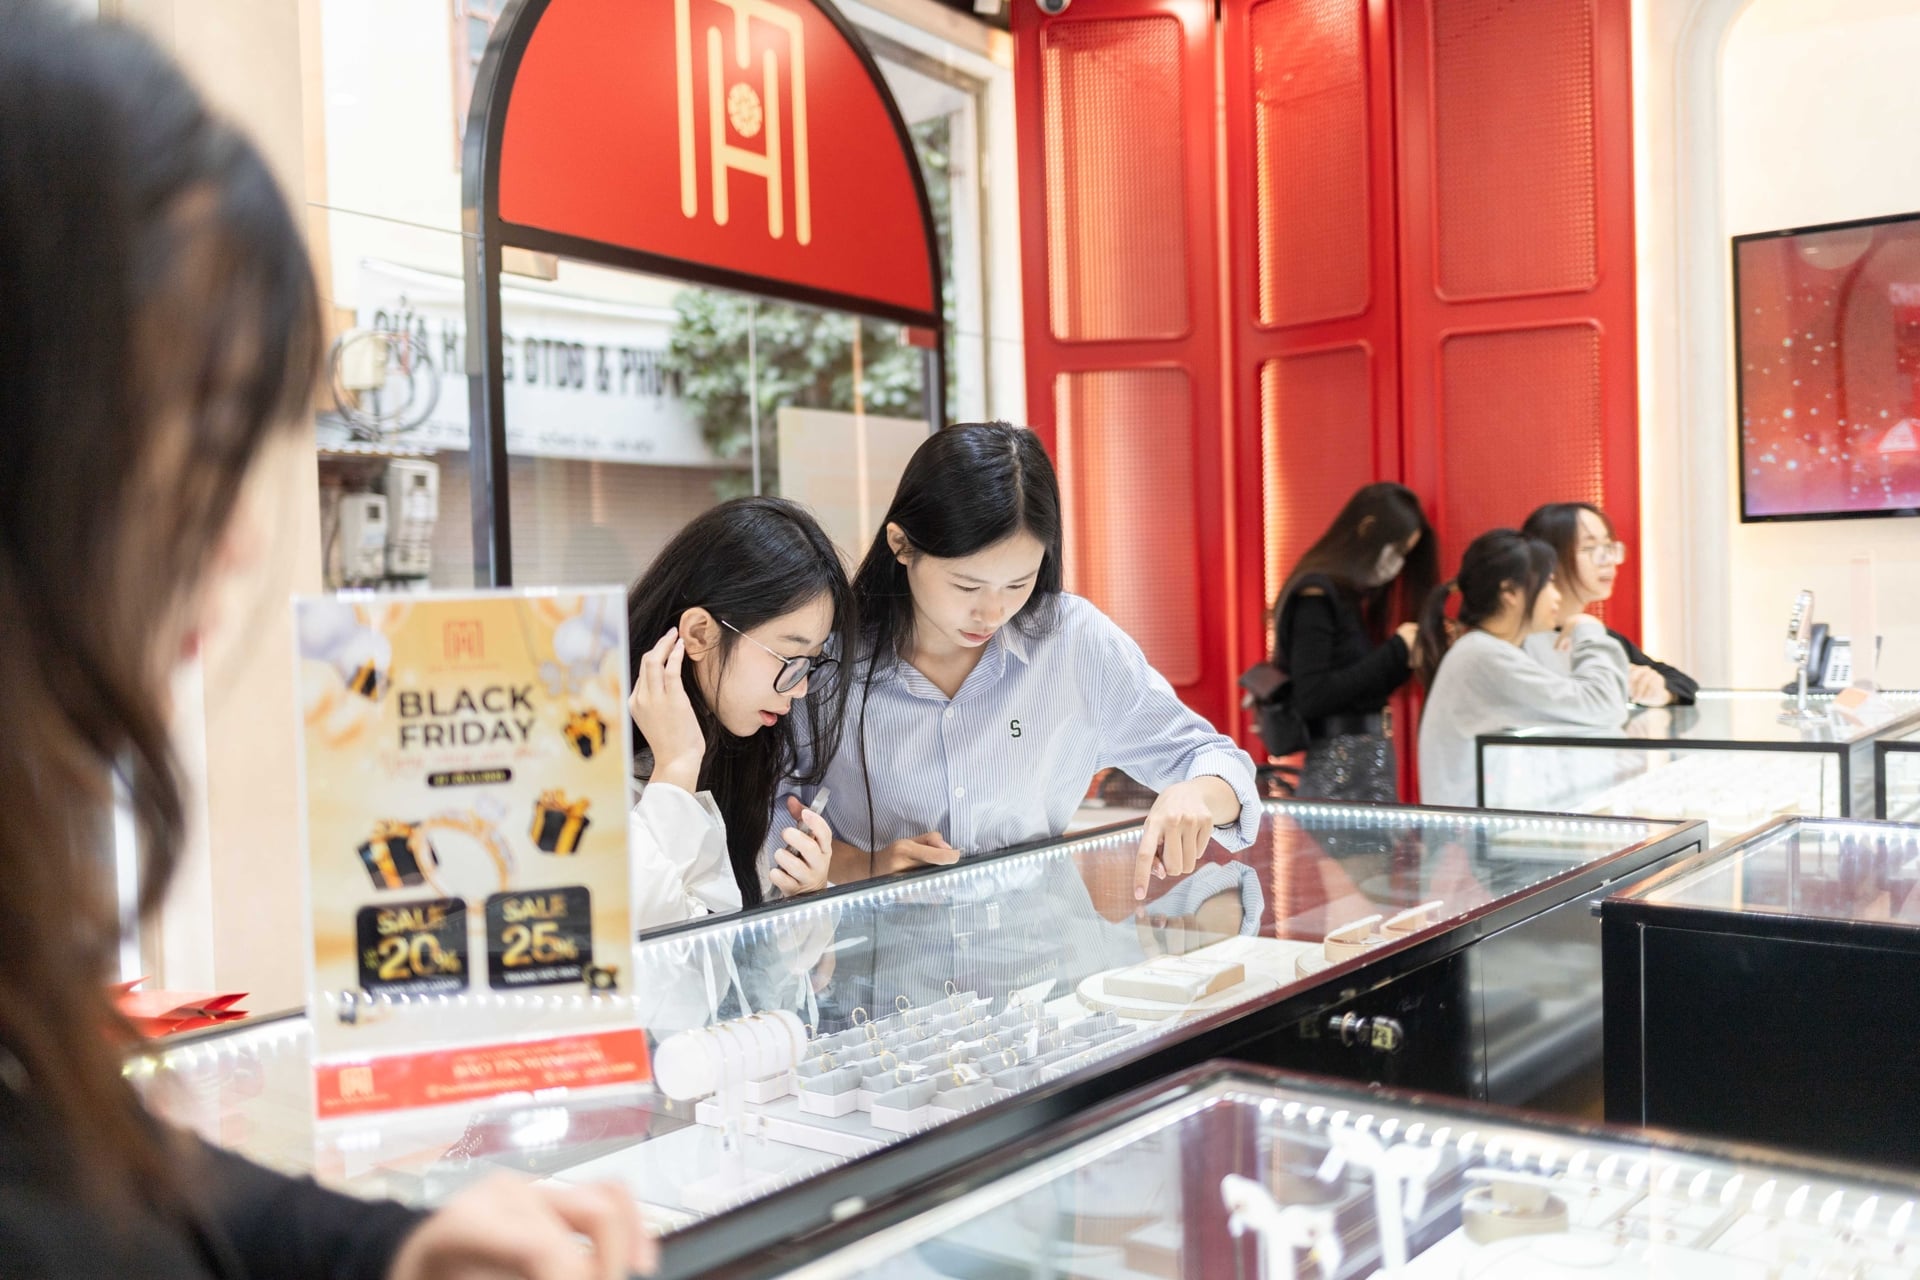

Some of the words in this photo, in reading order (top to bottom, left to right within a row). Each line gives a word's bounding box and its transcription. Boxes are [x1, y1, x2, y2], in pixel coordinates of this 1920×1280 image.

[399, 685, 533, 718] BLACK
[400, 718, 535, 749] FRIDAY
[1010, 719, 1021, 738] S
[377, 905, 447, 935] SALE
[502, 894, 568, 922] SALE
[378, 934, 462, 980] 20%
[501, 921, 579, 967] 25%
